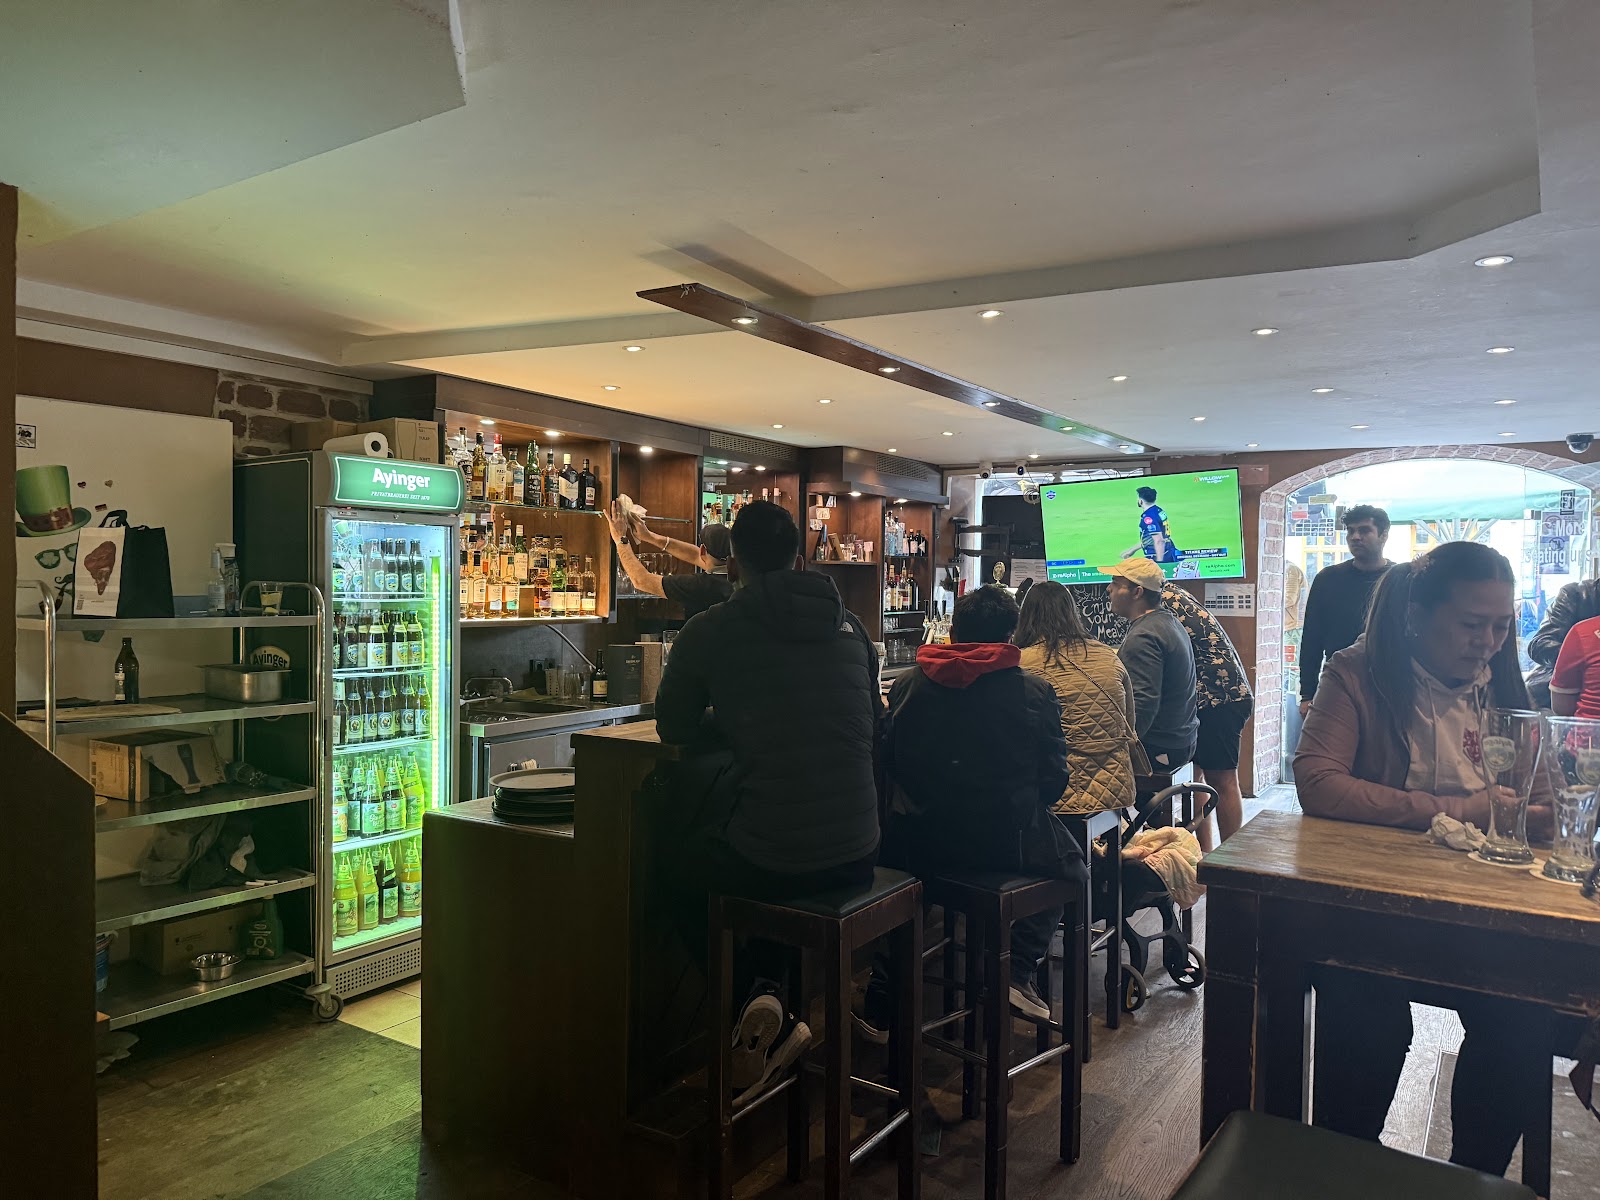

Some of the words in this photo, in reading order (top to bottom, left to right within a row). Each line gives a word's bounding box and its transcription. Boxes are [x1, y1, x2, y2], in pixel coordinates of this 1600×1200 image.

[372, 467, 430, 491] Ayinger
[1556, 519, 1585, 537] More
[1525, 547, 1566, 567] Seating
[1082, 600, 1113, 617] Enjo
